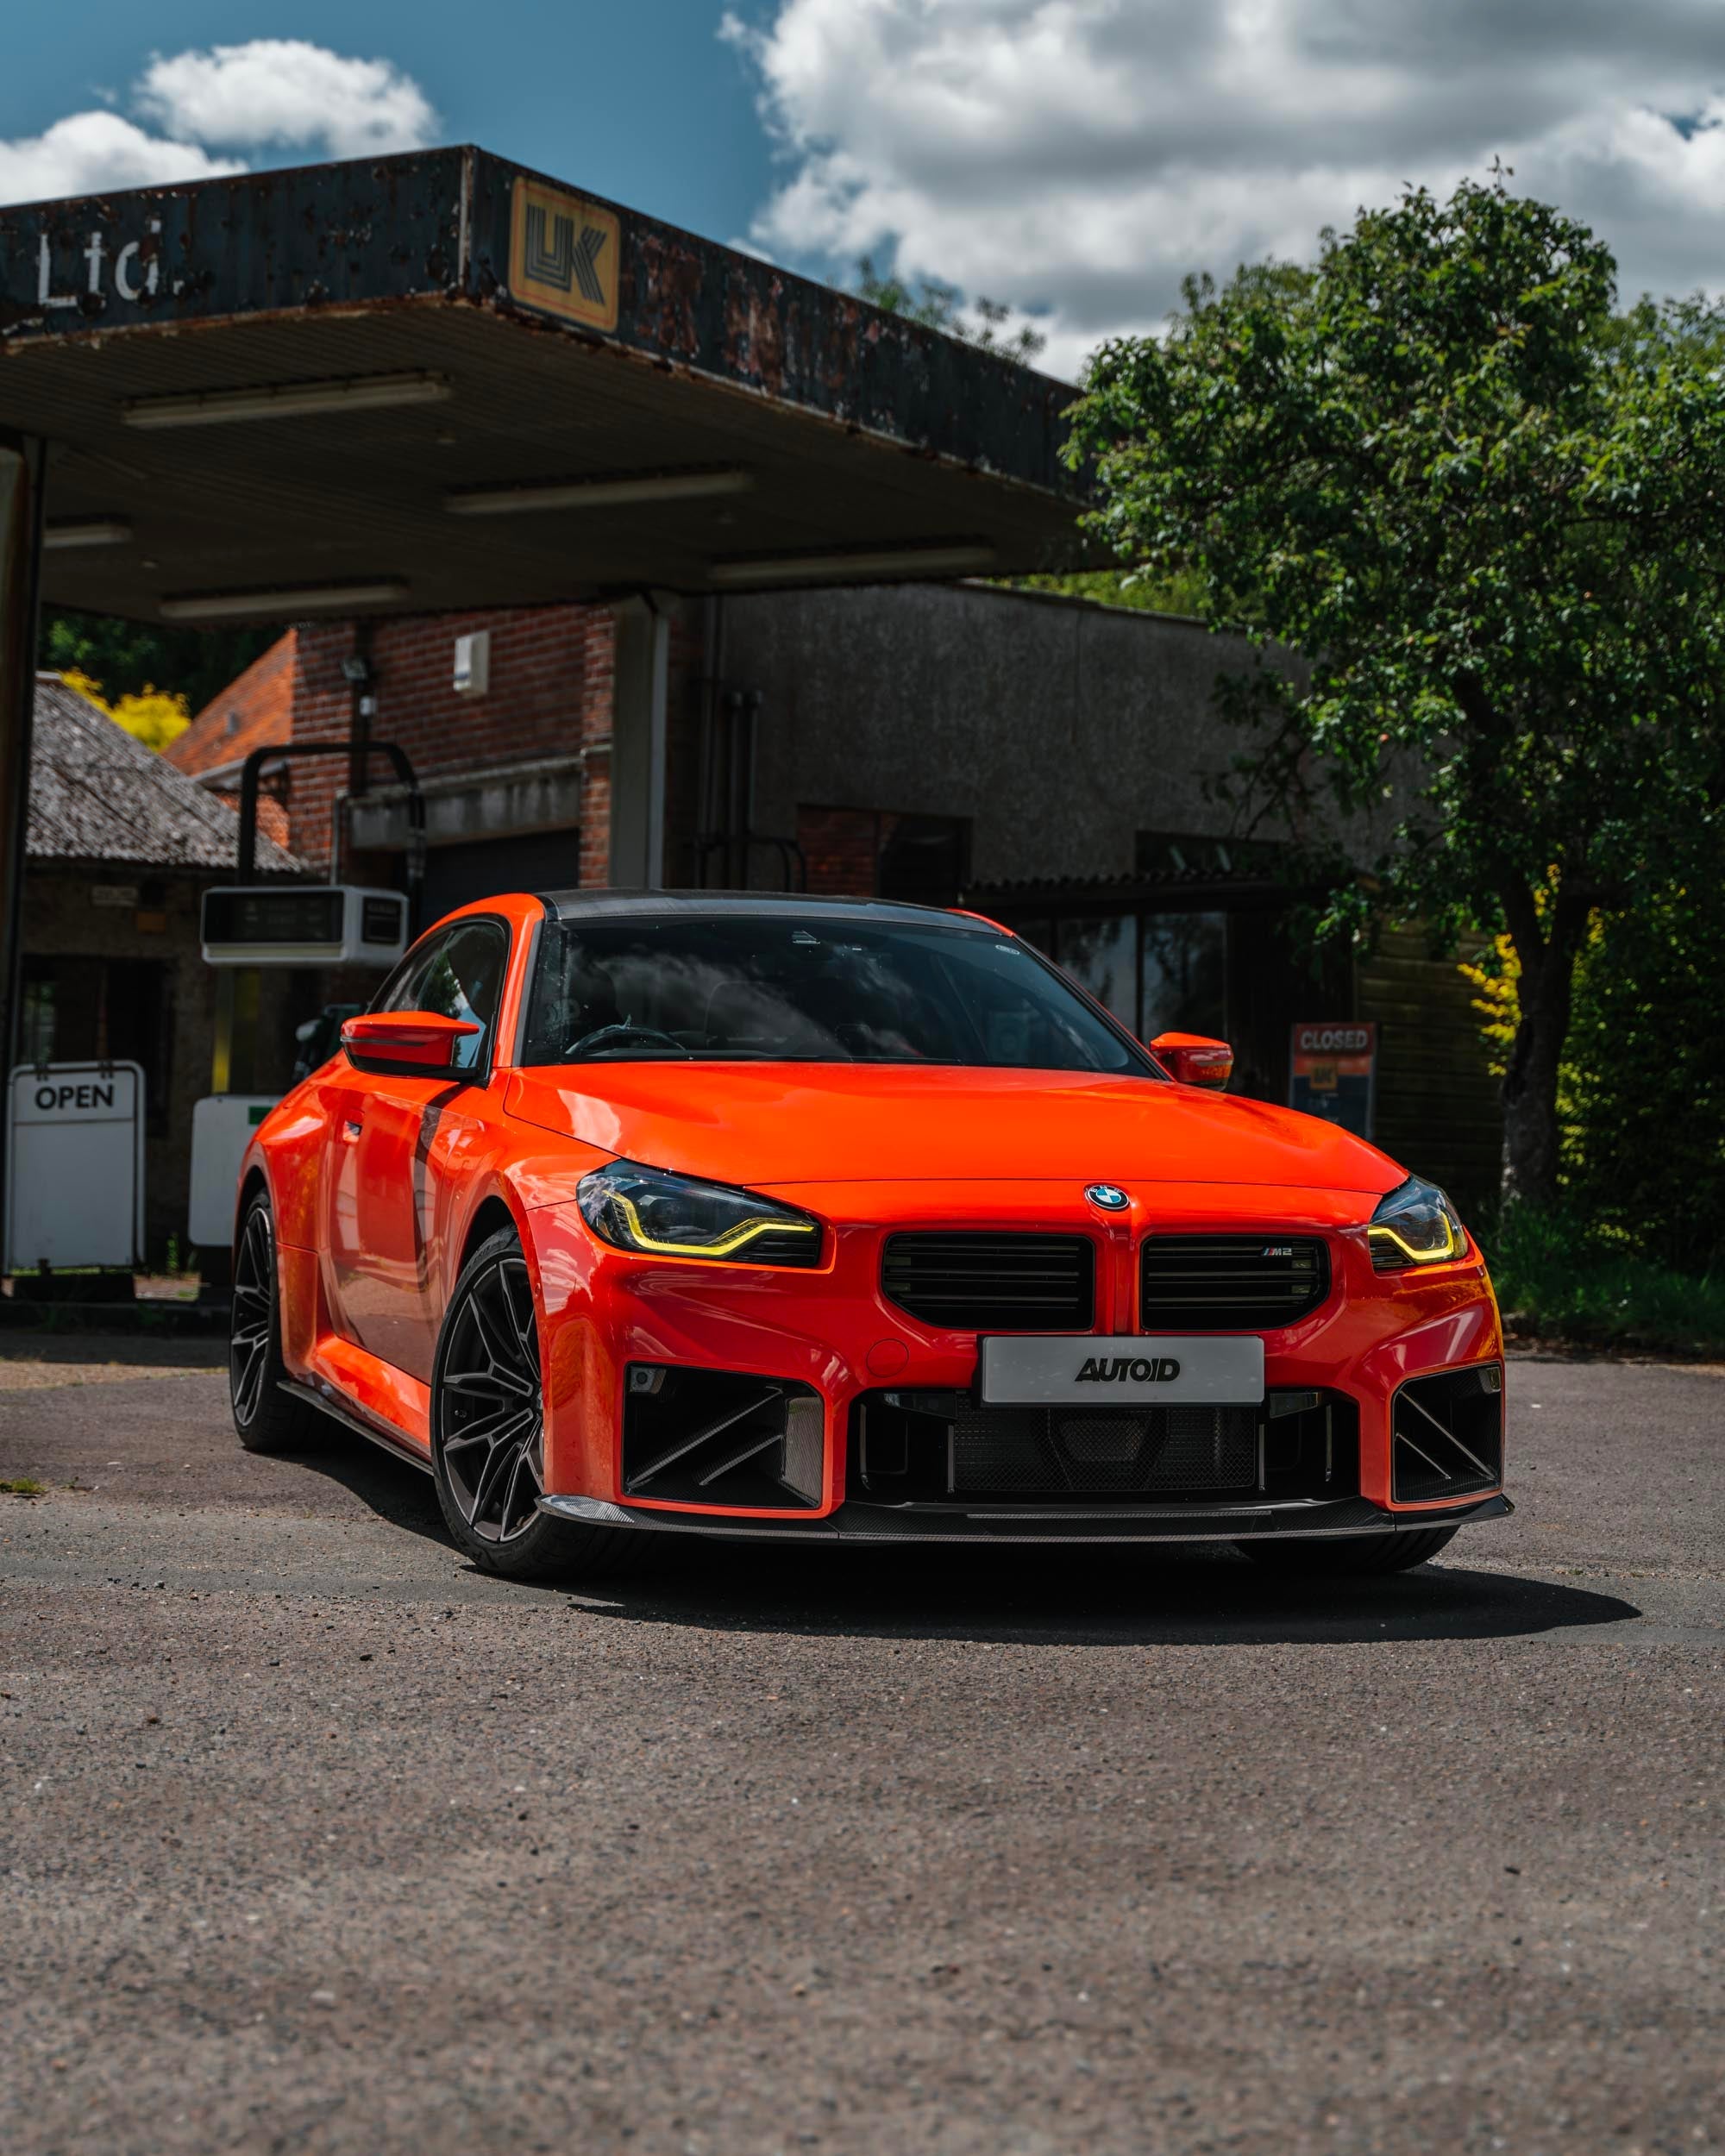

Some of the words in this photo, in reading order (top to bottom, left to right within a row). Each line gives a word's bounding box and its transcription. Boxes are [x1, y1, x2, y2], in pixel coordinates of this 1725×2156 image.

[524, 204, 607, 306] UK
[1301, 1030, 1367, 1049] CLOSED
[35, 1084, 115, 1110] OPEN
[1075, 1357, 1181, 1382] AUTOID
